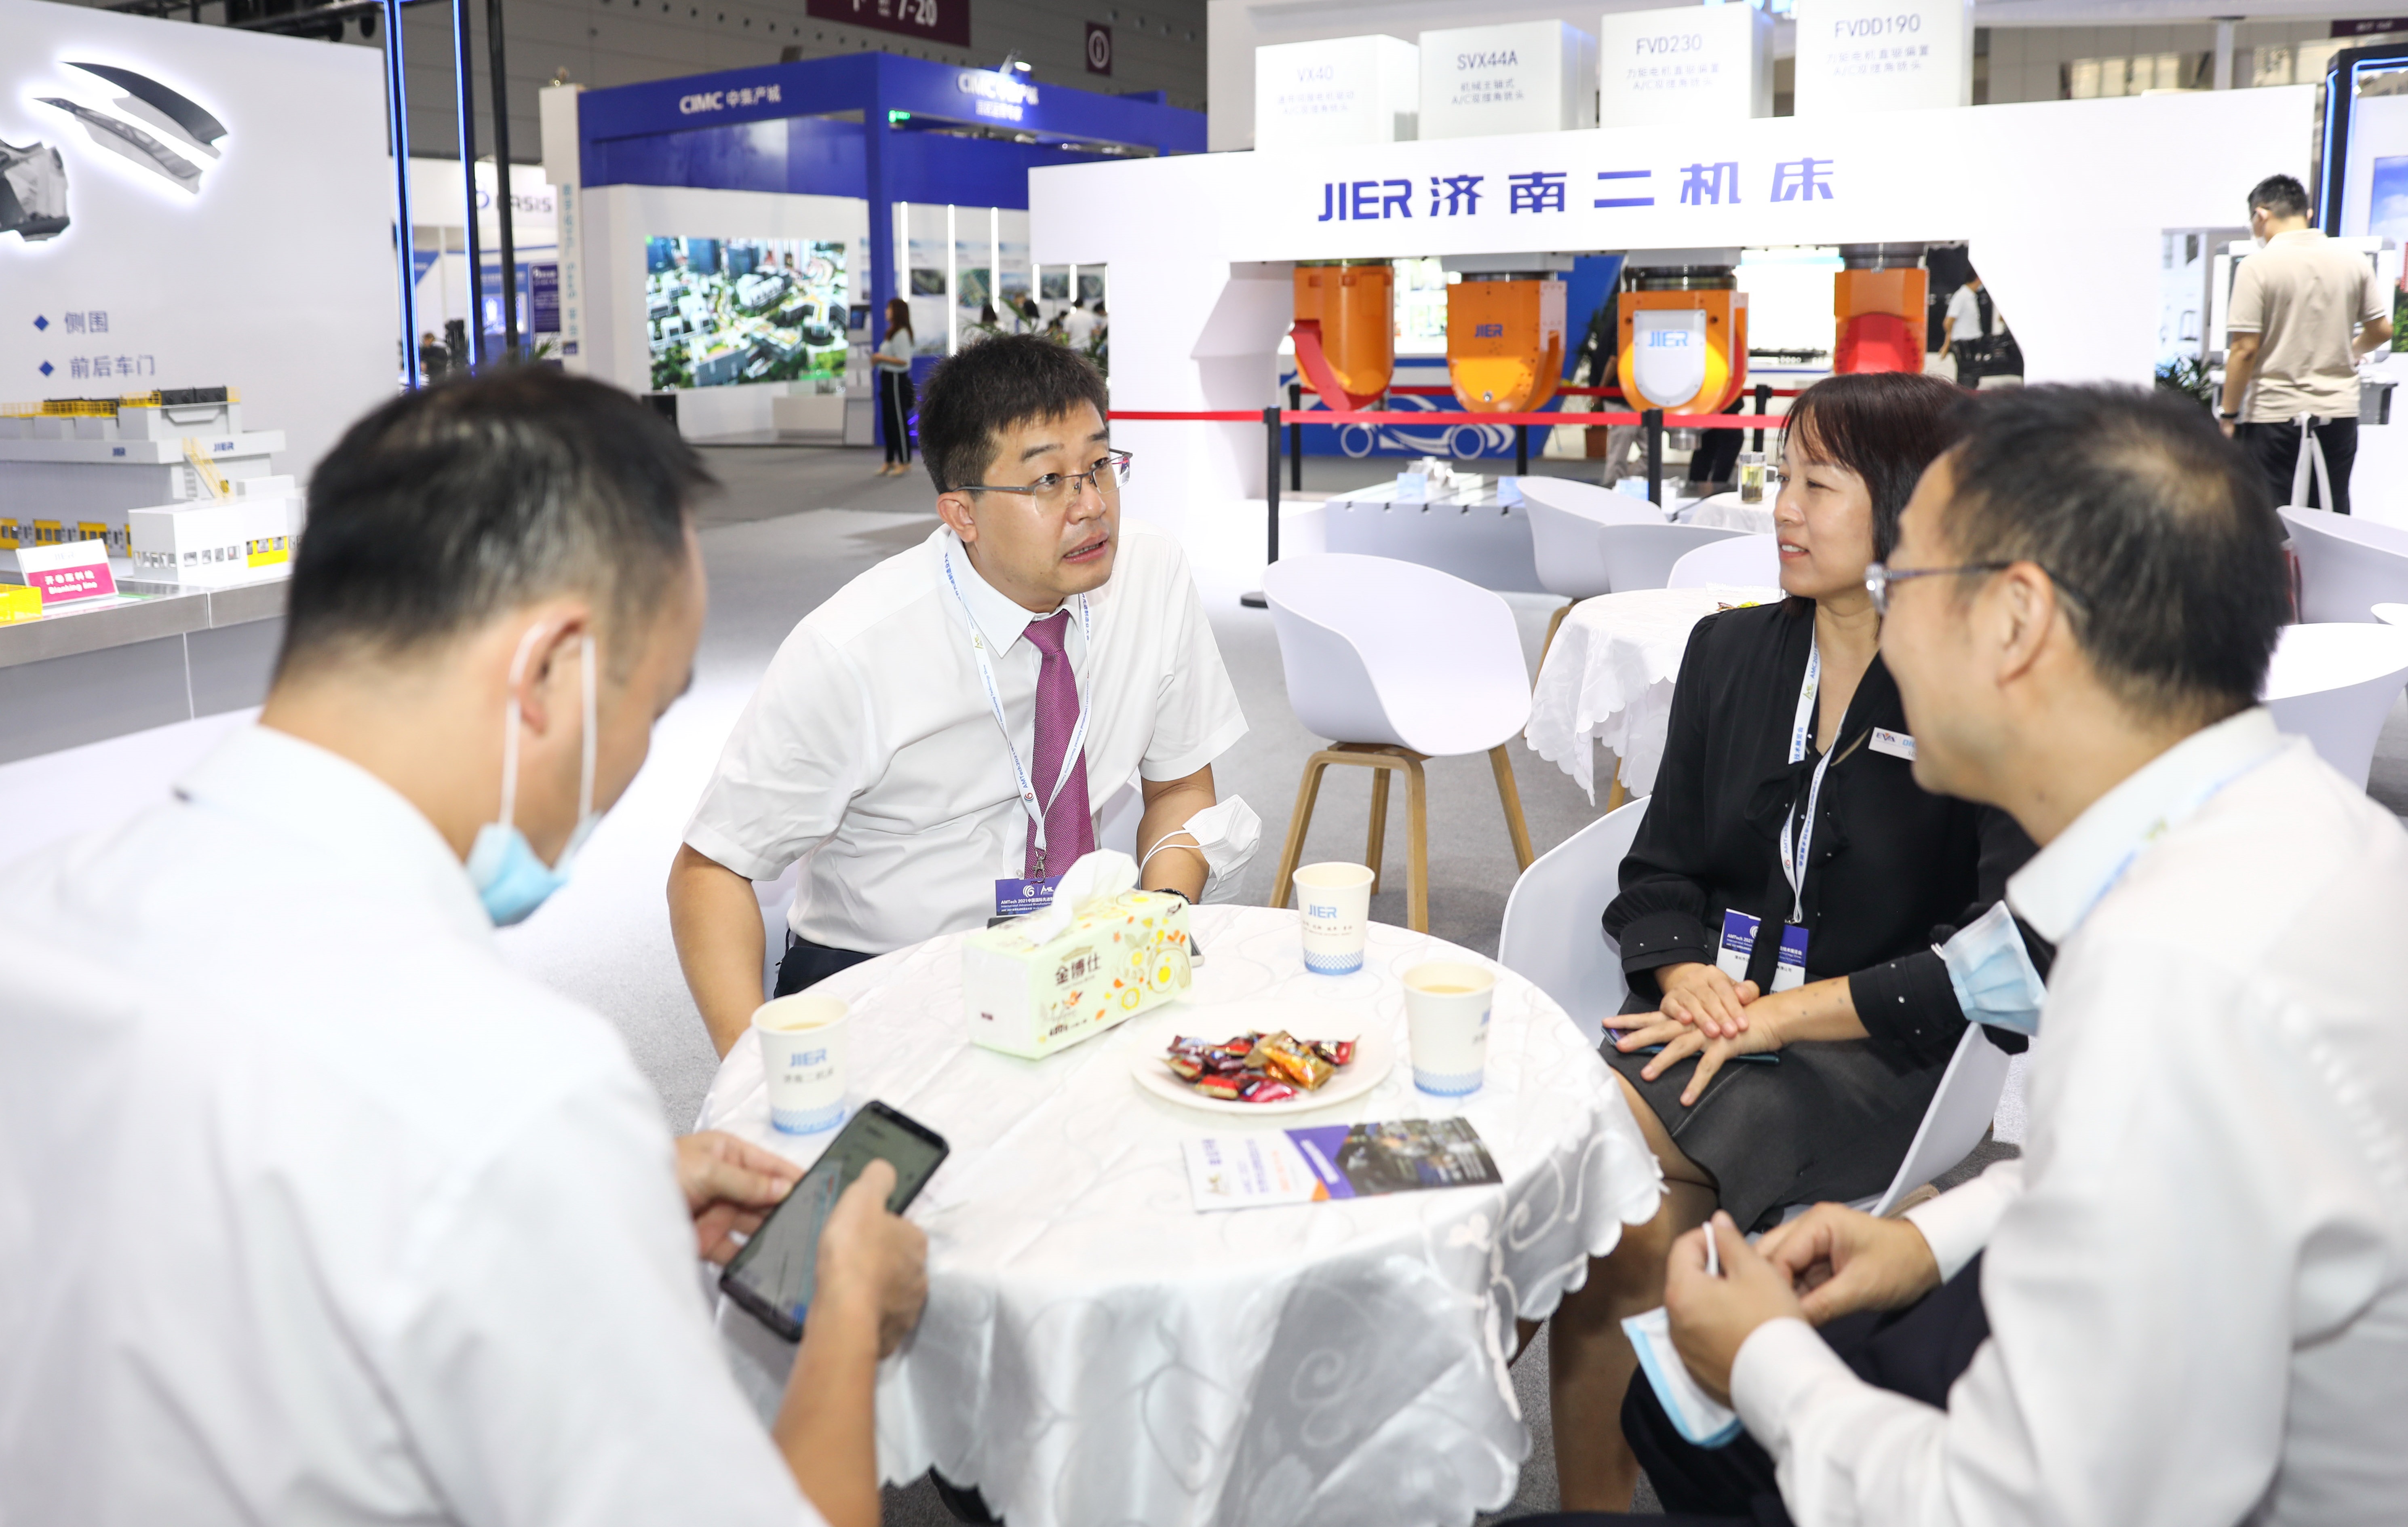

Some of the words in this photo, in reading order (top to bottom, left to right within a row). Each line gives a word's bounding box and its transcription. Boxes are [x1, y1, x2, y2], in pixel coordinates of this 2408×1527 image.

[1834, 13, 1921, 38] FVDD190
[1636, 33, 1703, 55] FVD230
[1457, 49, 1518, 70] SVX44A
[1297, 64, 1334, 82] VX40
[679, 91, 724, 114] CIMC
[1318, 179, 1413, 222] JIER
[1429, 157, 1834, 216] 济南二机床
[497, 194, 552, 212] ASIS
[64, 311, 109, 334] 侧围
[1475, 324, 1503, 338] JIER
[1647, 330, 1689, 348] JIER
[70, 355, 155, 379] 前后车门
[944, 552, 962, 602] 界先进制造业大会
[48, 584, 83, 595] Blanking
[82, 581, 98, 590] line
[985, 675, 995, 696] Technology
[1074, 730, 1083, 748] Advanced
[1307, 903, 1338, 919] JIER
[1054, 951, 1102, 986] 金博仕
[789, 1047, 827, 1067] JIER
